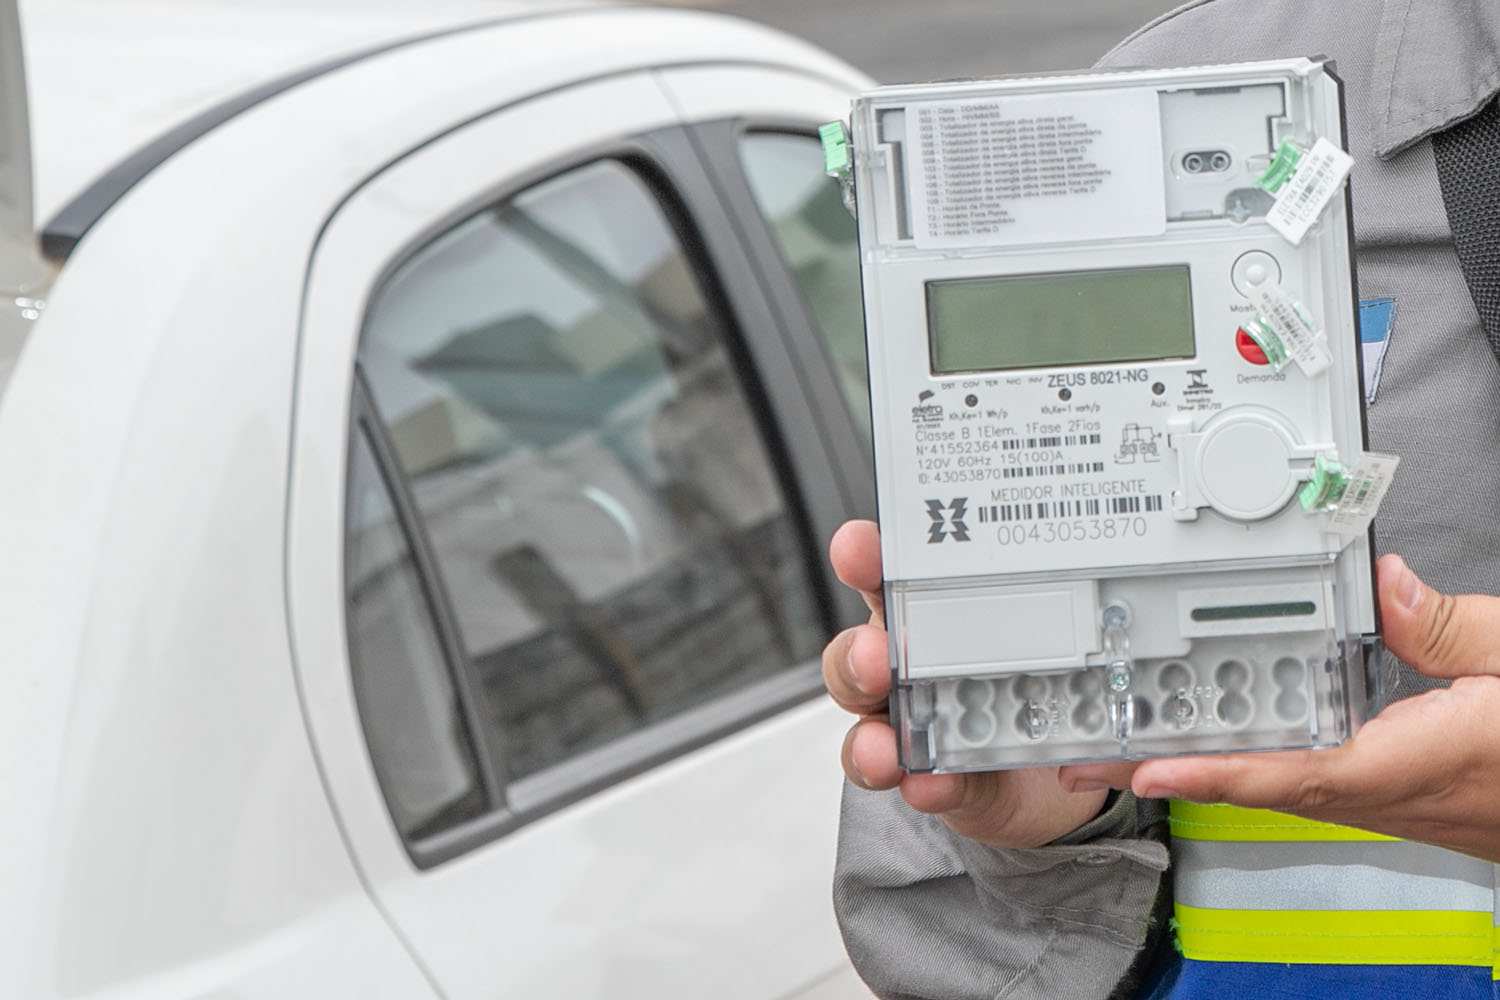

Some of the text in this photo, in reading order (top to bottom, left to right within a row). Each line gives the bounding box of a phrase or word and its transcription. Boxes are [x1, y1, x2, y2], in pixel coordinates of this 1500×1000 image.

[1048, 369, 1149, 388] ZEUS 8021-NG
[1237, 373, 1286, 384] Demanda
[915, 430, 955, 442] Classe
[961, 427, 970, 439] B
[1025, 423, 1061, 435] 1Fase
[1068, 420, 1101, 432] 2Fios
[918, 450, 1063, 470] 120V 60Hz 15(100)A
[934, 468, 1001, 483] 43053870
[990, 479, 1146, 502] MEDIDOR INTELIGENTE
[997, 516, 1147, 546] 0043053870
